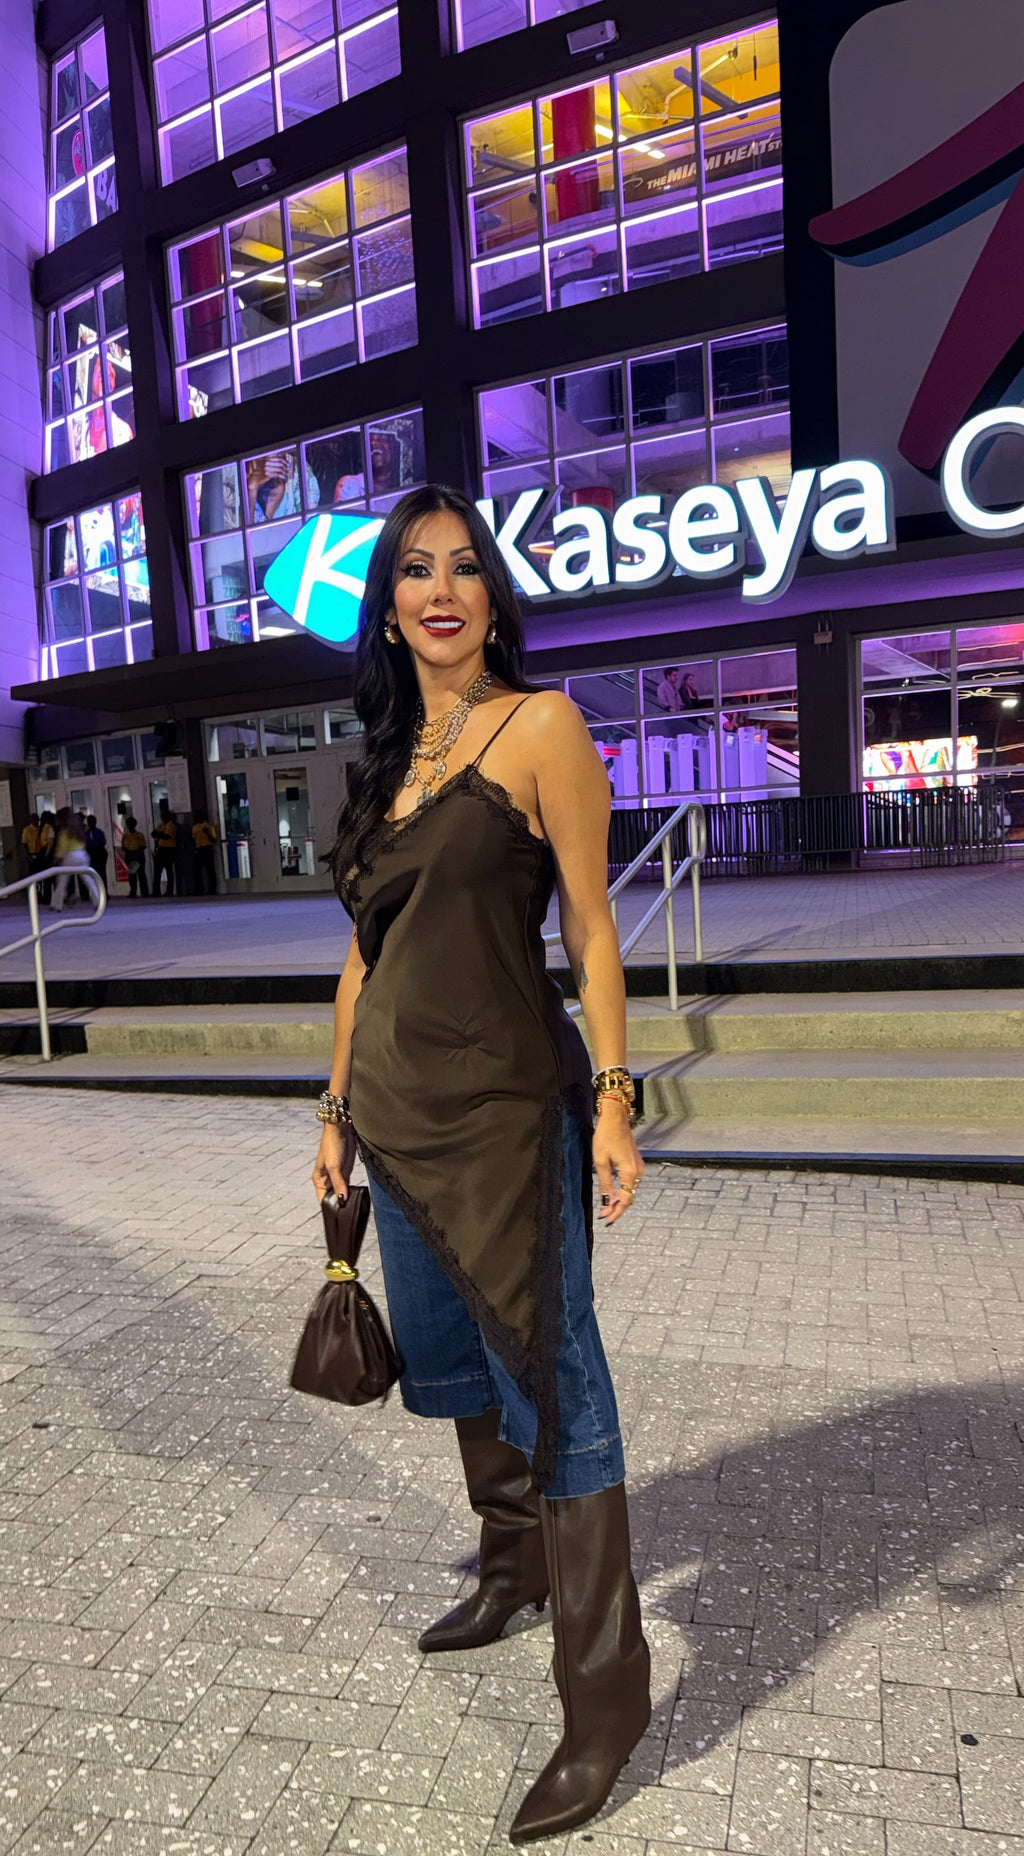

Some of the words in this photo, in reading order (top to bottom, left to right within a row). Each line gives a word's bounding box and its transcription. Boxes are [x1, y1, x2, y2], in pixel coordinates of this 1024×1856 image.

[647, 175, 667, 190] THE
[667, 156, 721, 184] MIAMI
[724, 134, 774, 166] HEAT
[475, 459, 889, 598] Kaseya
